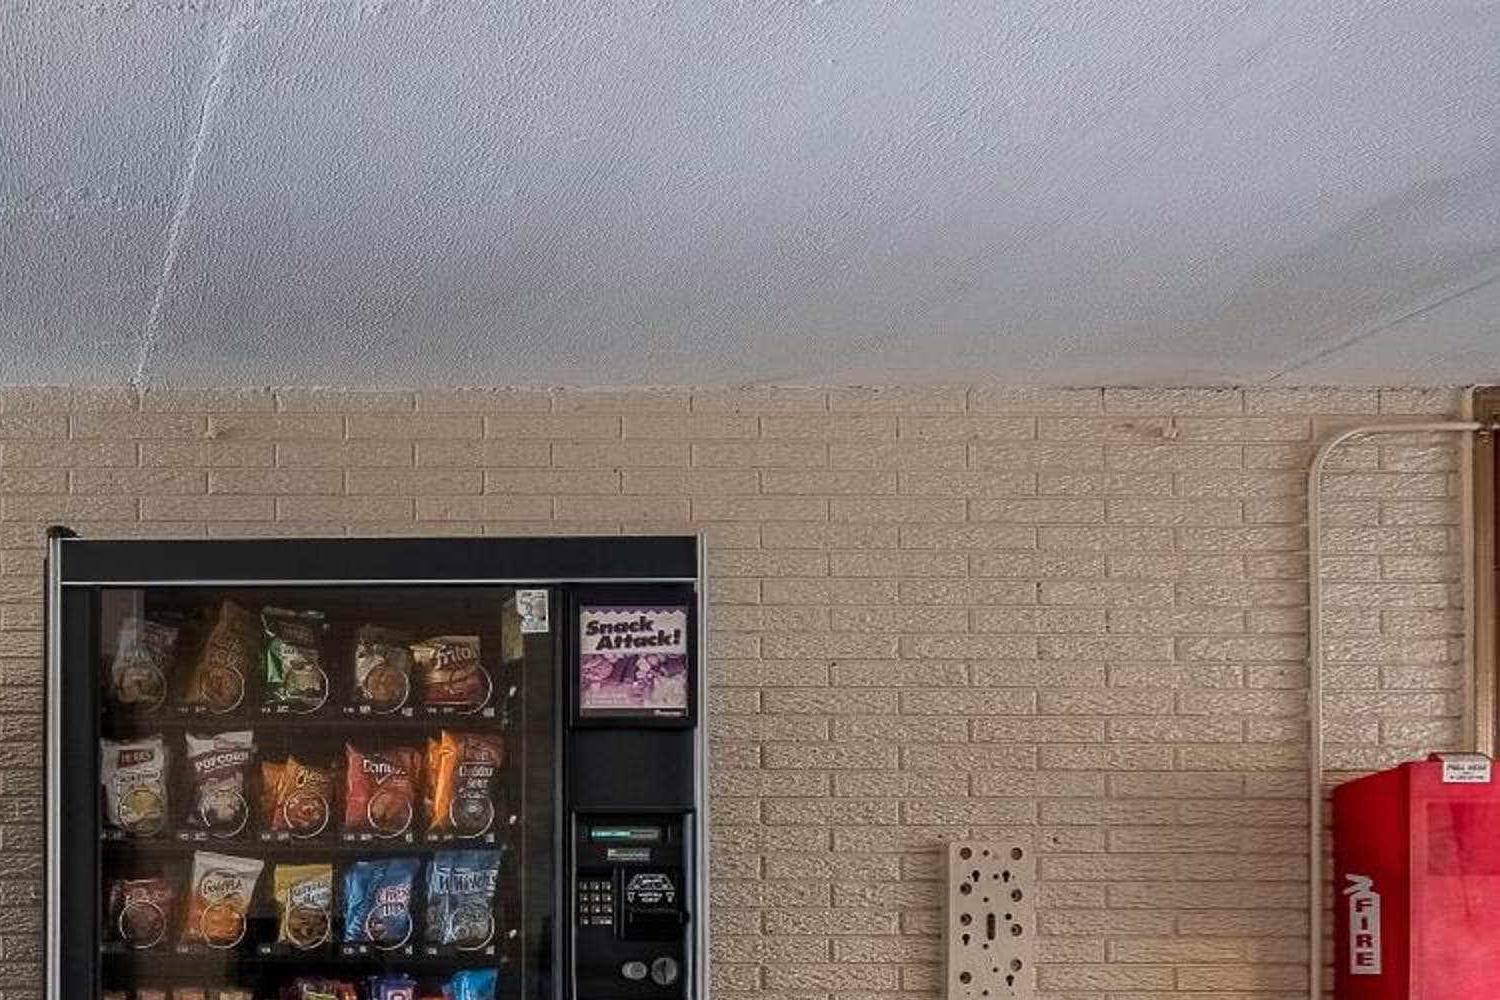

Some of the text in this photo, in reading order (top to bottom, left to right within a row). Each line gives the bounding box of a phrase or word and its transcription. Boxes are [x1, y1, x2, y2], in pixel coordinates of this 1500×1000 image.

[586, 616, 654, 636] Snack
[596, 629, 682, 650] Attack!
[1354, 898, 1375, 968] FIRE
